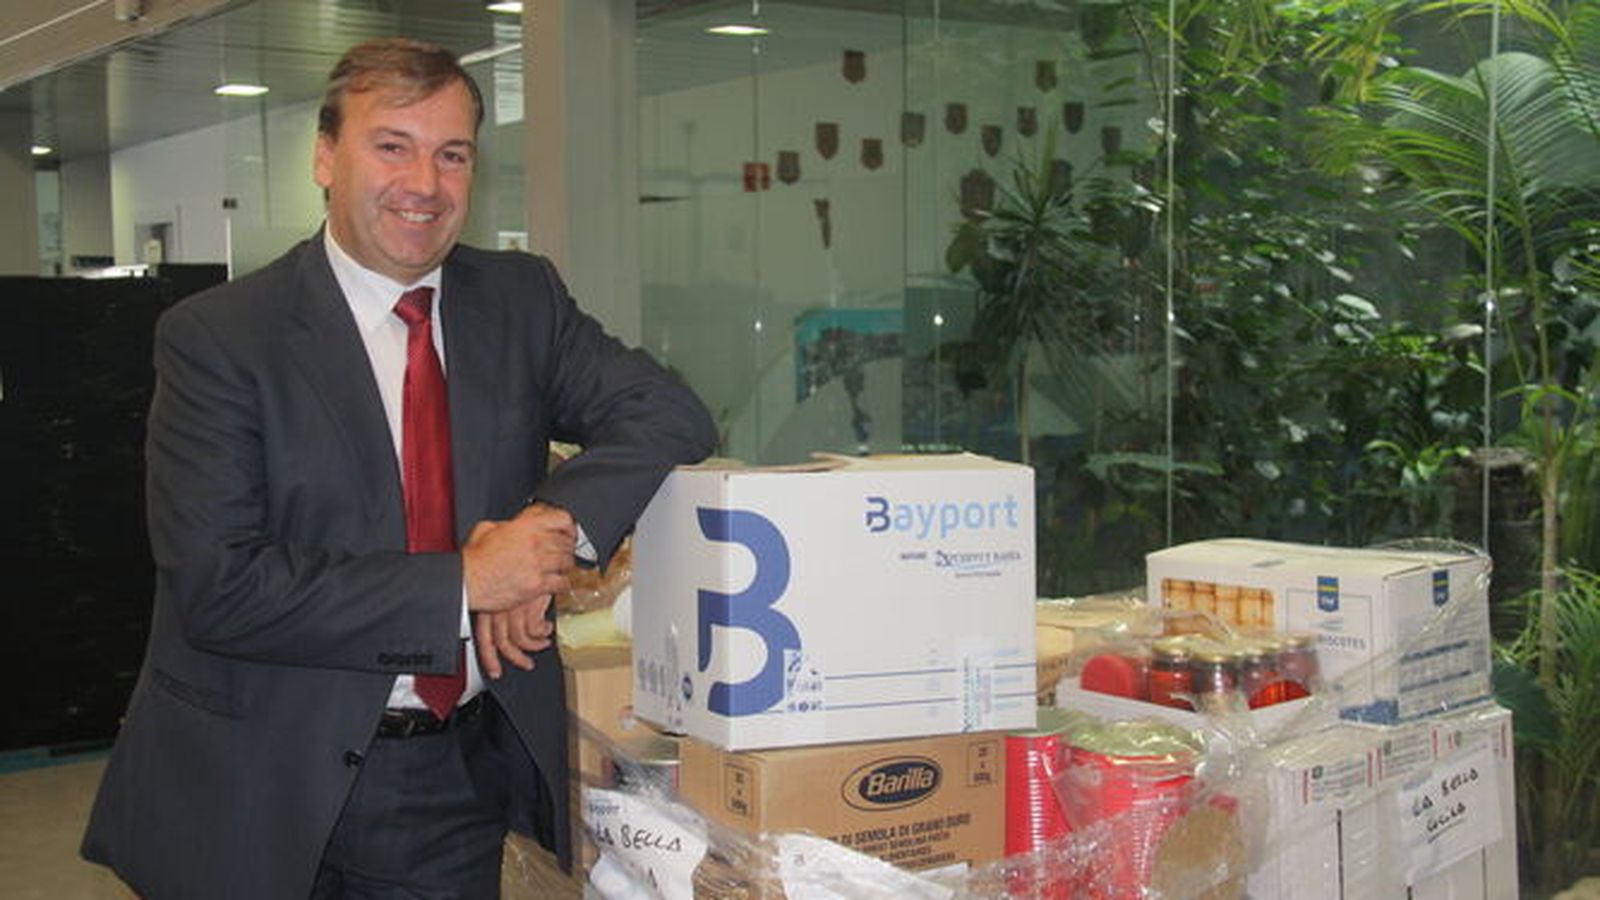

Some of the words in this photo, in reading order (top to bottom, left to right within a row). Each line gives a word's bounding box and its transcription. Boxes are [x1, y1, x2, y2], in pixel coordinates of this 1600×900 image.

[866, 495, 1018, 538] Bayport
[866, 767, 935, 797] Barilla
[855, 827, 896, 844] SEMOLA
